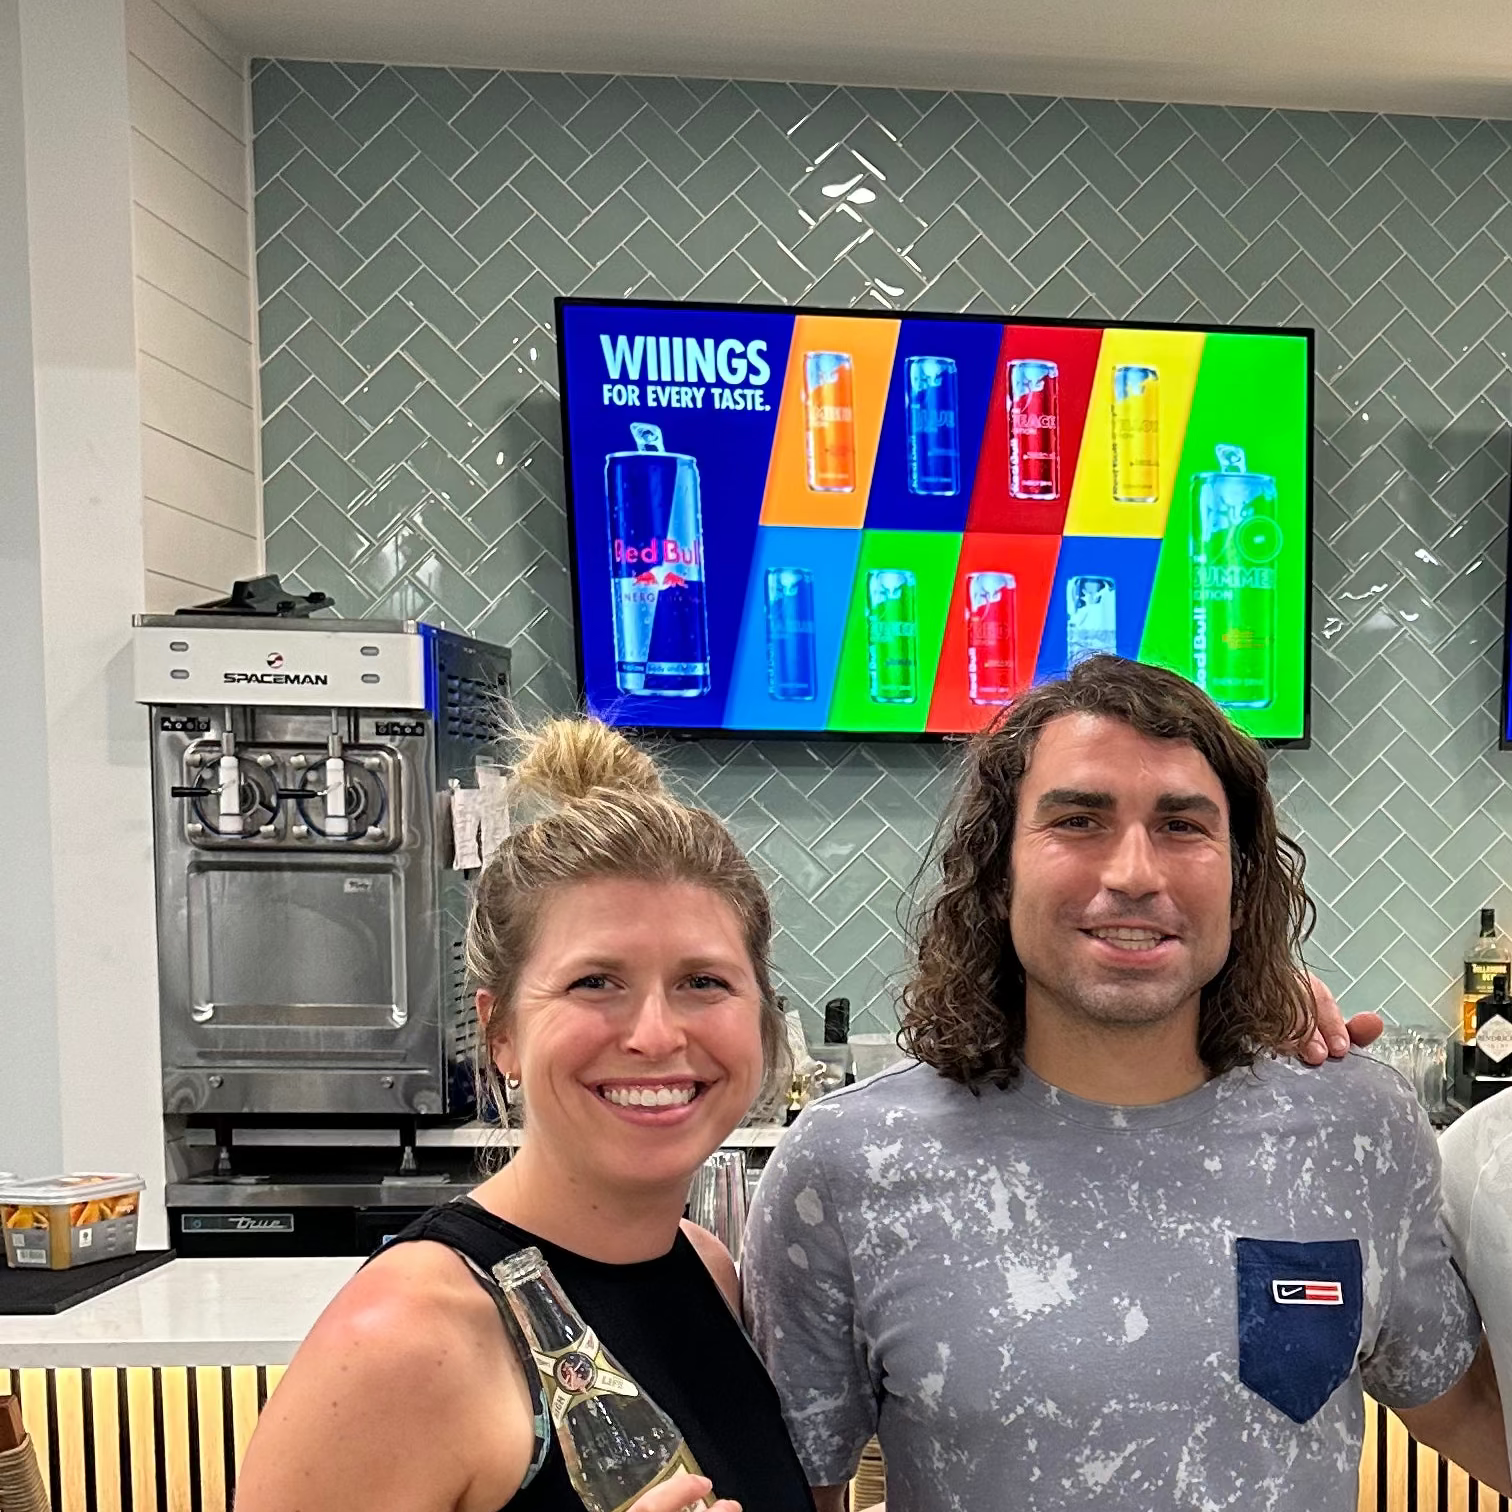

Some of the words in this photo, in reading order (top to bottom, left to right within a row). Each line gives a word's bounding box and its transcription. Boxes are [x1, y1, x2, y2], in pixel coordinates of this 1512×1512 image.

[599, 334, 771, 386] WIIINGS
[602, 384, 641, 407] FOR
[646, 385, 706, 409] EVERY
[710, 388, 772, 412] TASTE.
[223, 673, 328, 685] SPACEMAN
